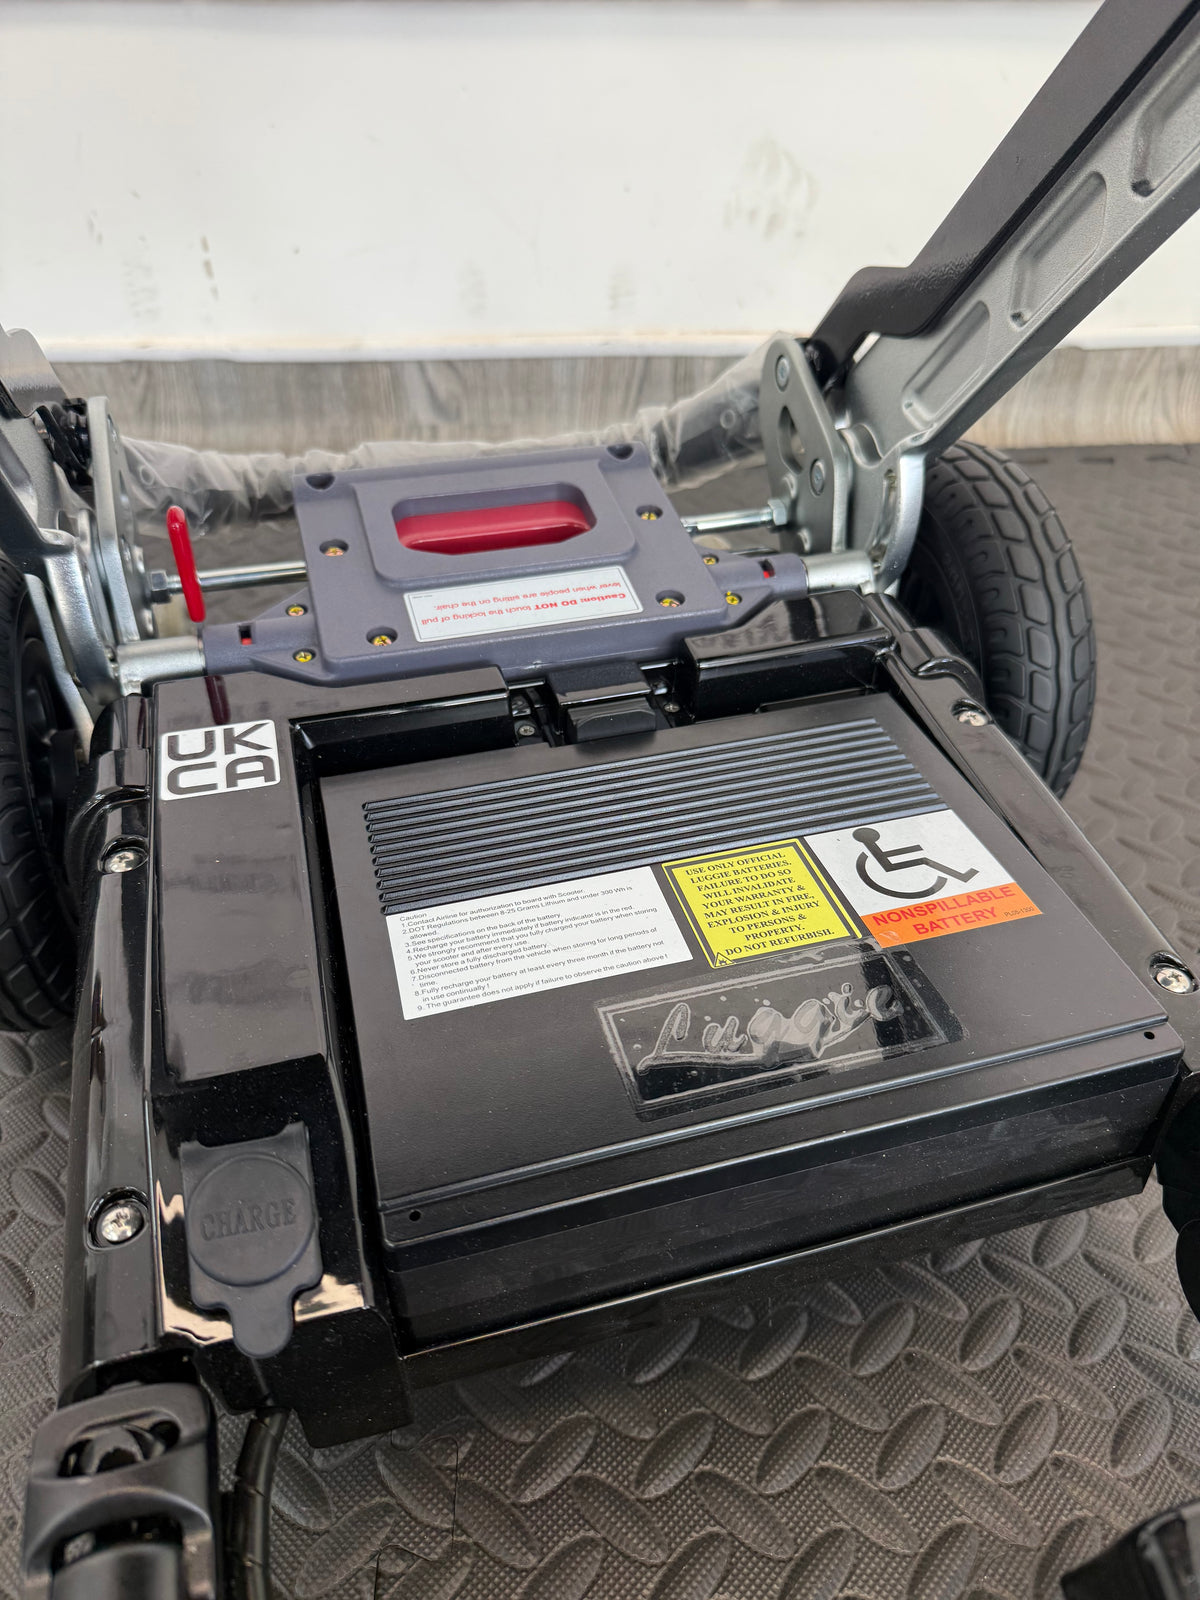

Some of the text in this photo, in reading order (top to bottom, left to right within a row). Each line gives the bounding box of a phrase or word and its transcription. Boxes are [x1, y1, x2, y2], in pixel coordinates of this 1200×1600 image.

[521, 592, 538, 600] are
[539, 587, 571, 598] people
[571, 584, 598, 593] when
[598, 581, 622, 590] lever
[421, 592, 627, 626] Caution: DO NOT touch the locking of pull
[433, 602, 460, 612] chair.
[492, 594, 521, 604] sitting
[167, 722, 272, 761] UK
[167, 755, 276, 795] CA
[685, 852, 786, 876] USE ONLY OFFICIAL
[690, 859, 792, 884] LUGGIE BATTERIES.
[696, 868, 792, 892] FAILURE TO DO SO
[702, 877, 796, 900] WILL INVALIDATE
[435, 913, 458, 922] Airline
[469, 902, 514, 915] authorization
[521, 896, 543, 905] board
[702, 898, 734, 910] YOUR
[734, 886, 794, 903] WARRANTY
[703, 892, 815, 919] MAY RESULT IN FIRE,
[872, 887, 1015, 926] NONSPILLABLE
[399, 912, 427, 922] Caution
[426, 918, 469, 930] Regulations
[469, 911, 500, 922] between
[499, 908, 516, 916] 8-25
[516, 903, 541, 912] Grams
[540, 898, 566, 908] Lithium
[566, 895, 580, 903] and
[579, 892, 600, 900] under
[707, 900, 820, 928] EXPLOSION & INJURY
[728, 913, 807, 934] TO PERSONS &
[913, 907, 998, 935] BATTERY
[427, 929, 476, 944] specifications
[498, 921, 517, 930] back
[427, 947, 457, 958] strongly
[457, 937, 500, 952] recommend
[500, 935, 515, 943] that
[515, 932, 529, 941] you
[529, 929, 544, 937] fully
[544, 923, 574, 934] charged
[573, 920, 589, 929] your
[589, 915, 614, 925] battery
[614, 911, 634, 919] when
[633, 907, 658, 916] storing
[448, 938, 465, 947] your
[465, 933, 491, 943] battery
[491, 924, 534, 938] immediately
[539, 919, 564, 928] battery
[564, 913, 595, 923] indicator
[725, 928, 835, 956] DO NOT REFURBISH.
[744, 923, 805, 941] PROPERTY.
[414, 959, 432, 968] your
[432, 953, 460, 964] scooter
[460, 949, 475, 958] and
[475, 946, 493, 955] after
[493, 942, 514, 951] every
[440, 961, 460, 969] store
[466, 956, 482, 964] fully
[482, 947, 522, 961] discharged
[469, 960, 496, 970] battery
[495, 957, 513, 965] from
[525, 949, 552, 958] vehicle
[551, 945, 572, 953] when
[572, 939, 597, 949] storing
[607, 934, 624, 942] long
[623, 929, 650, 940] periods
[650, 926, 658, 934] of
[440, 979, 474, 991] recharge
[474, 976, 492, 985] your
[492, 970, 518, 980] battery
[526, 964, 546, 973] least
[545, 960, 566, 969] every
[566, 956, 586, 965] three
[586, 951, 610, 961] month
[614, 948, 627, 956] the
[626, 942, 652, 952] battery
[419, 980, 438, 988] time.
[425, 1001, 442, 1009] The
[442, 993, 481, 1007] guarantee
[481, 989, 501, 998] does
[501, 985, 514, 994] not
[514, 982, 535, 991] apply
[541, 976, 564, 985] failure
[572, 967, 603, 978] observe
[615, 959, 642, 969] caution
[642, 954, 665, 964] above
[430, 993, 445, 1001] use
[445, 984, 486, 998] continually
[201, 1198, 297, 1241] CHARGE
